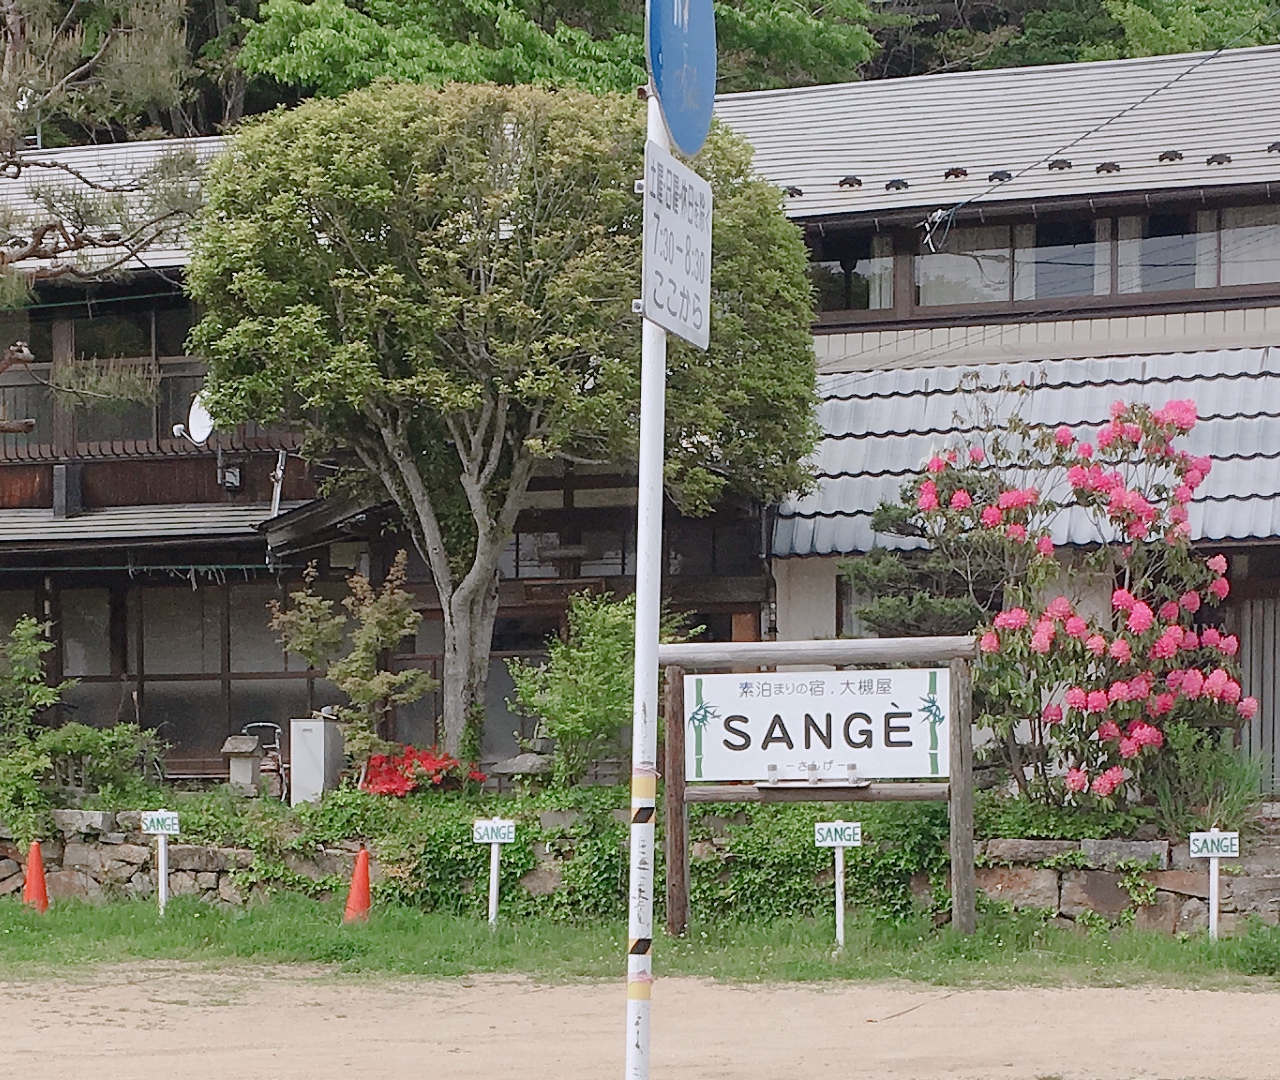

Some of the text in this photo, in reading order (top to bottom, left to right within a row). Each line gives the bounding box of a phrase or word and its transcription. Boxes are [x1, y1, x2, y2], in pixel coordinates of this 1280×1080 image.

[653, 270, 703, 330] ここから
[722, 701, 913, 752] SANGÈ
[141, 817, 179, 832] SANGE
[474, 825, 514, 840] SANGE
[816, 826, 860, 843] SANGE
[1191, 836, 1239, 854] SANGE
